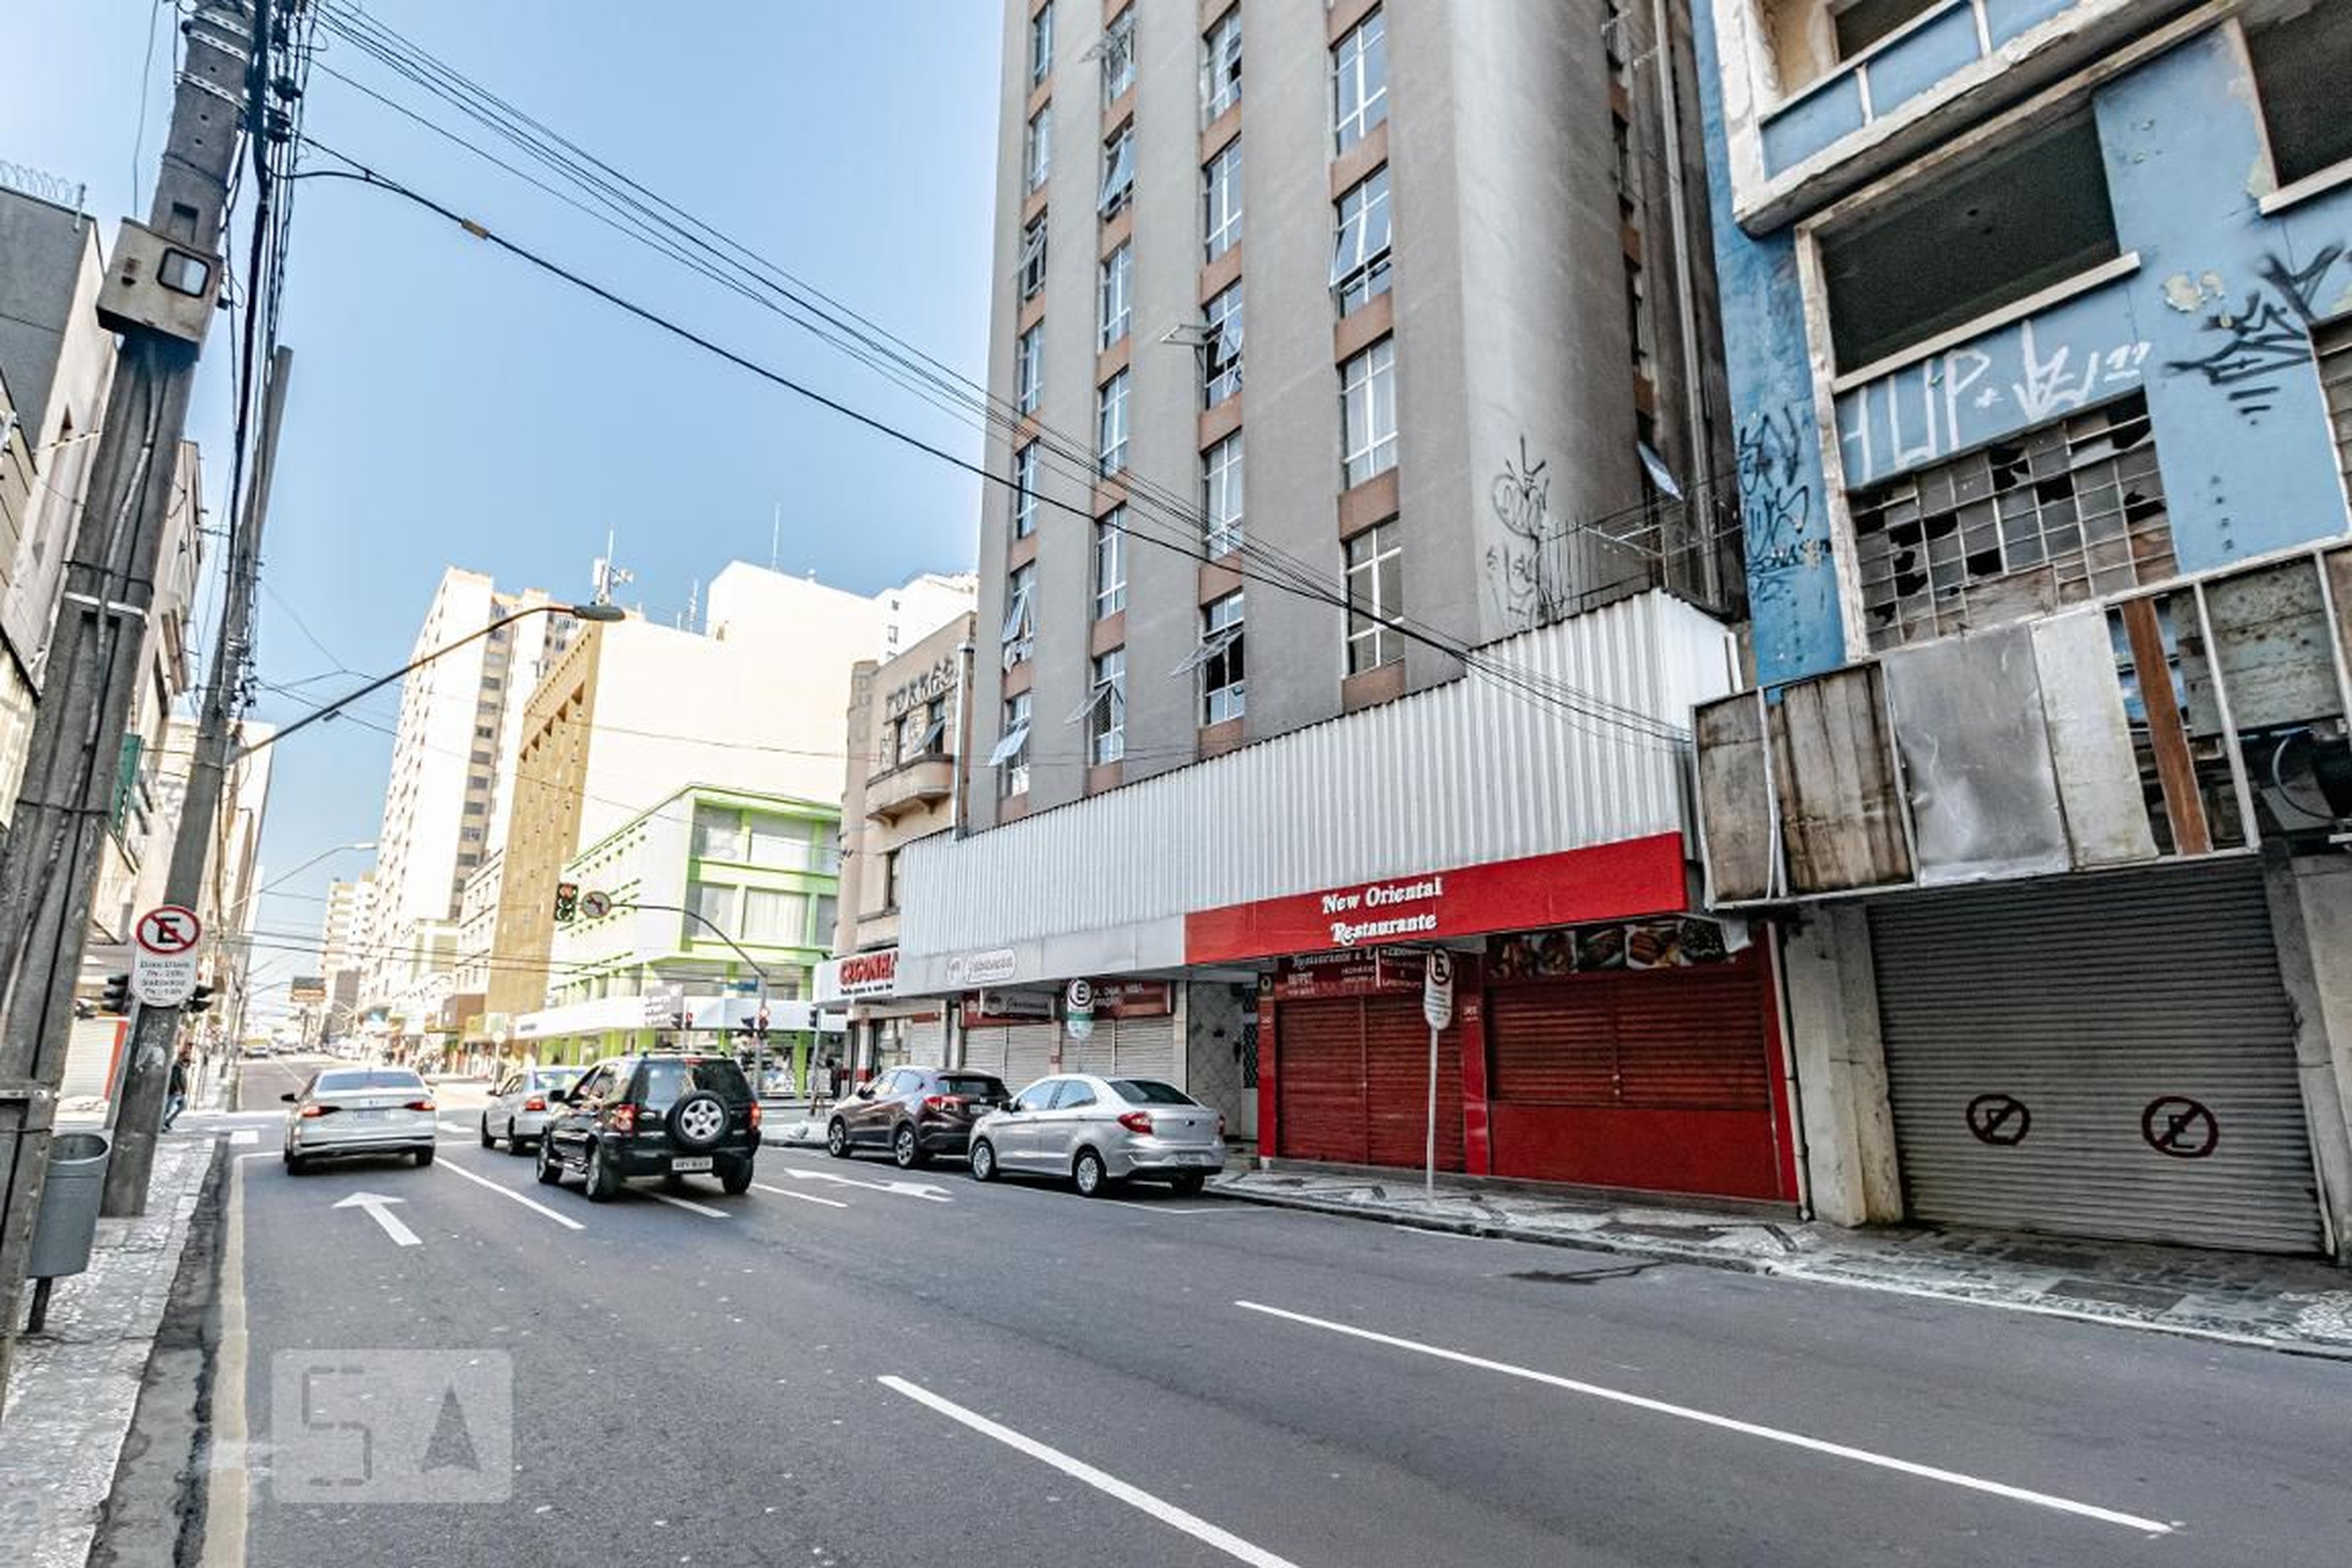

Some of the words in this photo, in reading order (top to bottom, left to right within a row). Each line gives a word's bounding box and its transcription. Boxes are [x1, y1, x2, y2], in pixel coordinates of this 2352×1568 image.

[1322, 894, 1360, 914] New
[1365, 875, 1444, 907] Oriental
[157, 917, 181, 943] E
[1330, 913, 1438, 946] Restaurante
